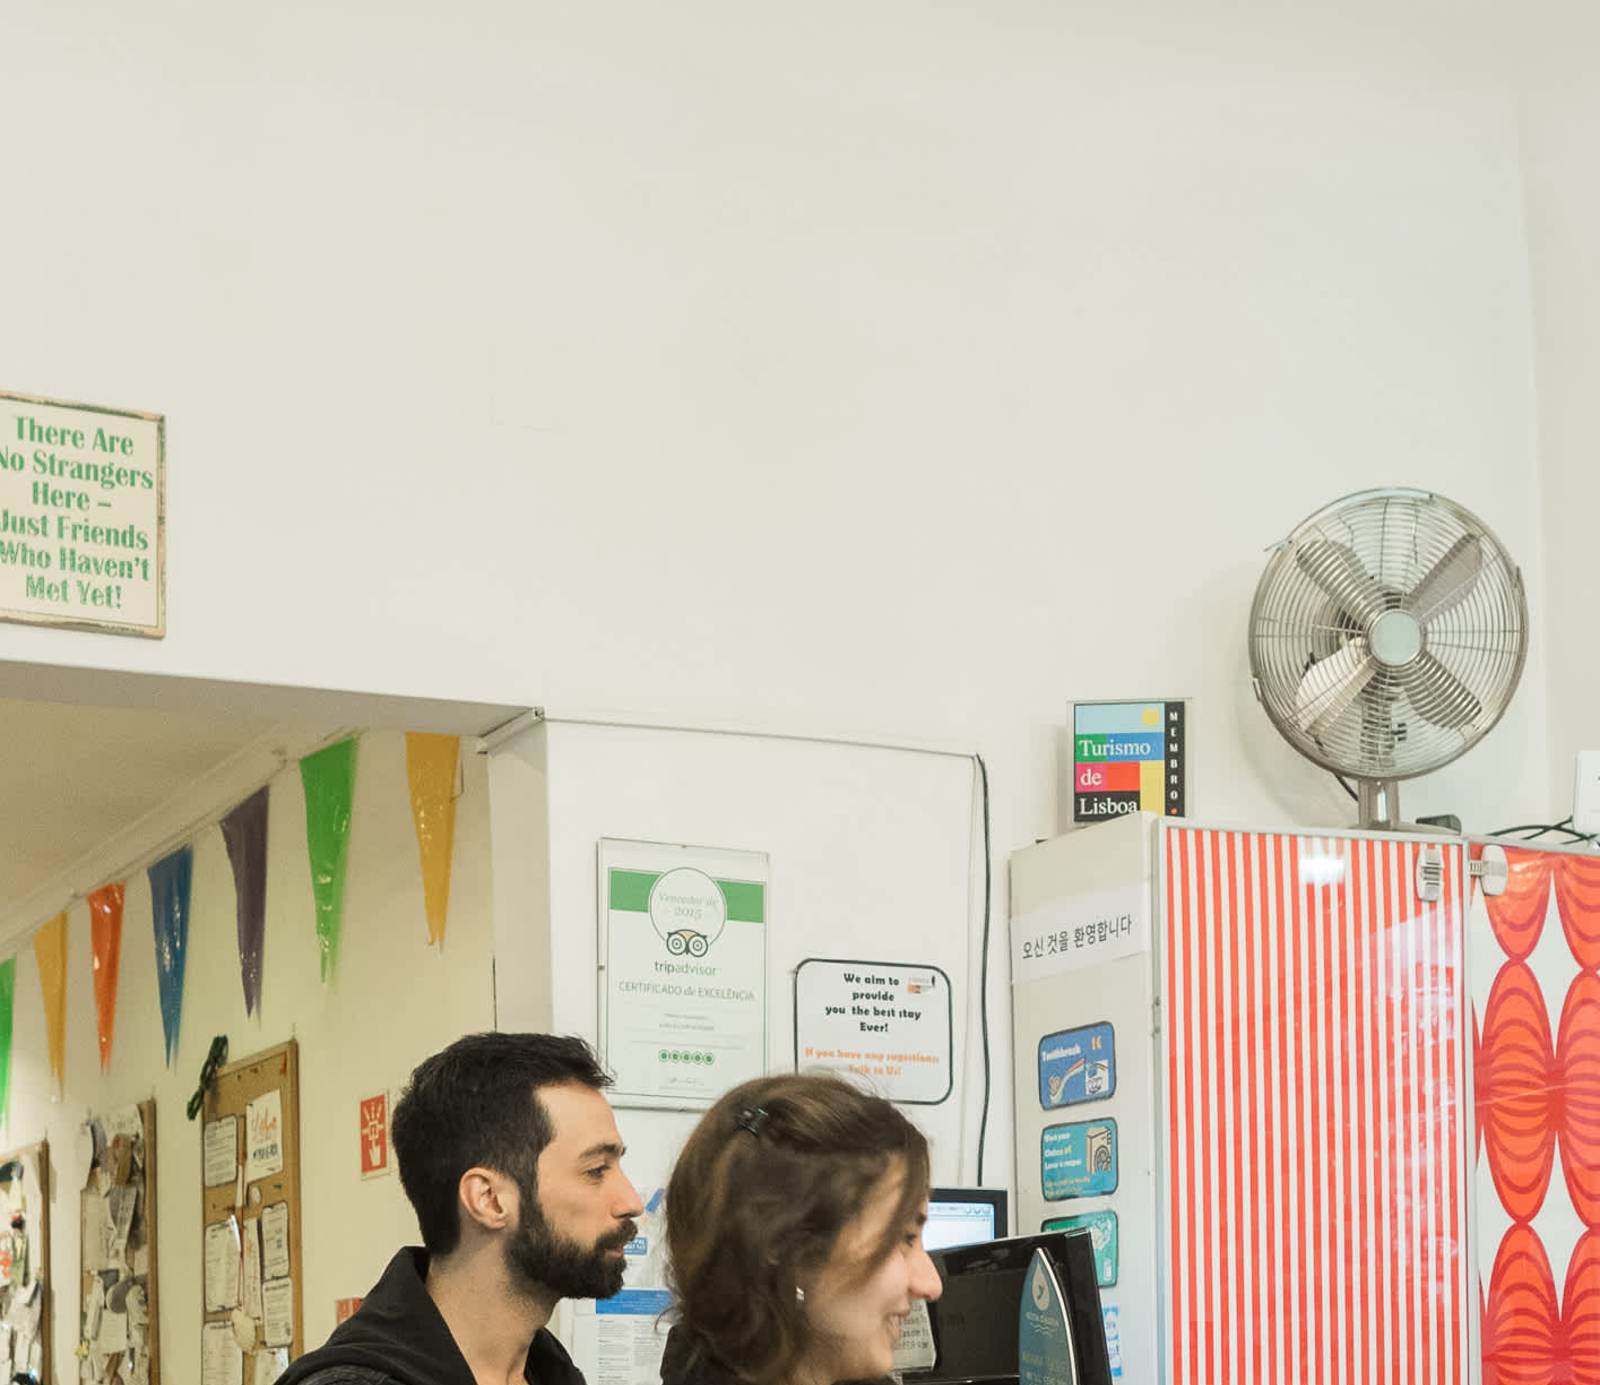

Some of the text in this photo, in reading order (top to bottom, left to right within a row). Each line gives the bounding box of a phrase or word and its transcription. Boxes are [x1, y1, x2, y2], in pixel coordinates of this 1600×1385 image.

[16, 416, 134, 456] There Are
[33, 449, 153, 489] Strangers
[32, 481, 90, 510] Here
[0, 509, 149, 550] Just Friends
[0, 540, 150, 582] Who Haven't
[26, 574, 123, 609] Met Yet!
[1079, 739, 1151, 757] Turismo
[1169, 712, 1178, 800] MEMBRO
[1080, 769, 1102, 786] de
[1080, 798, 1138, 815] Lisboa
[1022, 913, 1133, 959] 오신 것을 환영합니다
[654, 960, 717, 976] tripadvisor
[619, 980, 682, 996] CERTIFICADO
[844, 973, 900, 986] We aim to
[852, 990, 895, 1002] provide
[825, 1006, 922, 1021] you the best stay
[860, 1022, 889, 1033] Ever!
